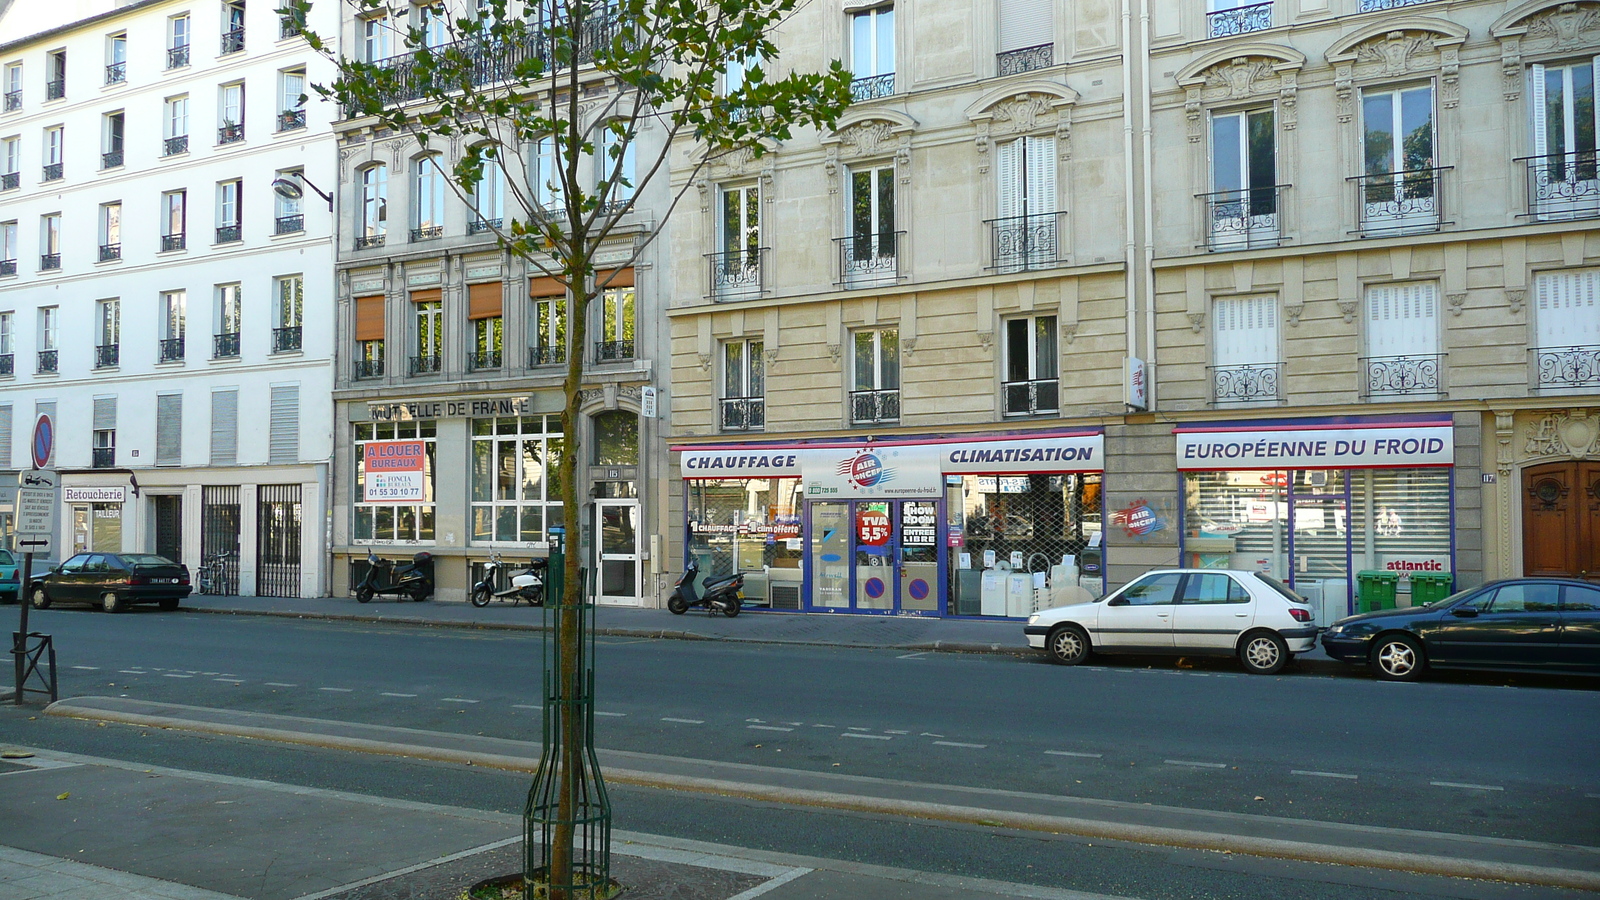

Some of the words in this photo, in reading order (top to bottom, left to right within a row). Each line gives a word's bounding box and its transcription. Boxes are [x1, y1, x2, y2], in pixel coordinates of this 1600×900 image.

[371, 403, 441, 420] MUTELLE
[447, 402, 465, 416] DE
[368, 446, 376, 457] A
[380, 444, 421, 457] LOUER
[1184, 438, 1327, 459] EUROPÉENNE
[1334, 439, 1366, 456] DU
[1373, 437, 1444, 455] FROID
[949, 447, 1093, 463] CLIMATISATION
[371, 458, 416, 468] BUREAUX
[686, 455, 796, 469] CHAUFFAGE
[856, 459, 876, 471] AIR
[1483, 474, 1494, 483] 117
[66, 488, 122, 500] Retoucherie
[369, 488, 377, 496] 01
[379, 488, 388, 496] 55
[390, 488, 398, 496] 30
[400, 488, 409, 496] 10
[410, 487, 419, 495] 77
[862, 517, 888, 526] TVA
[1131, 510, 1150, 521] AIR
[861, 527, 888, 543] 5,5%
[1386, 559, 1442, 571] atlantic
